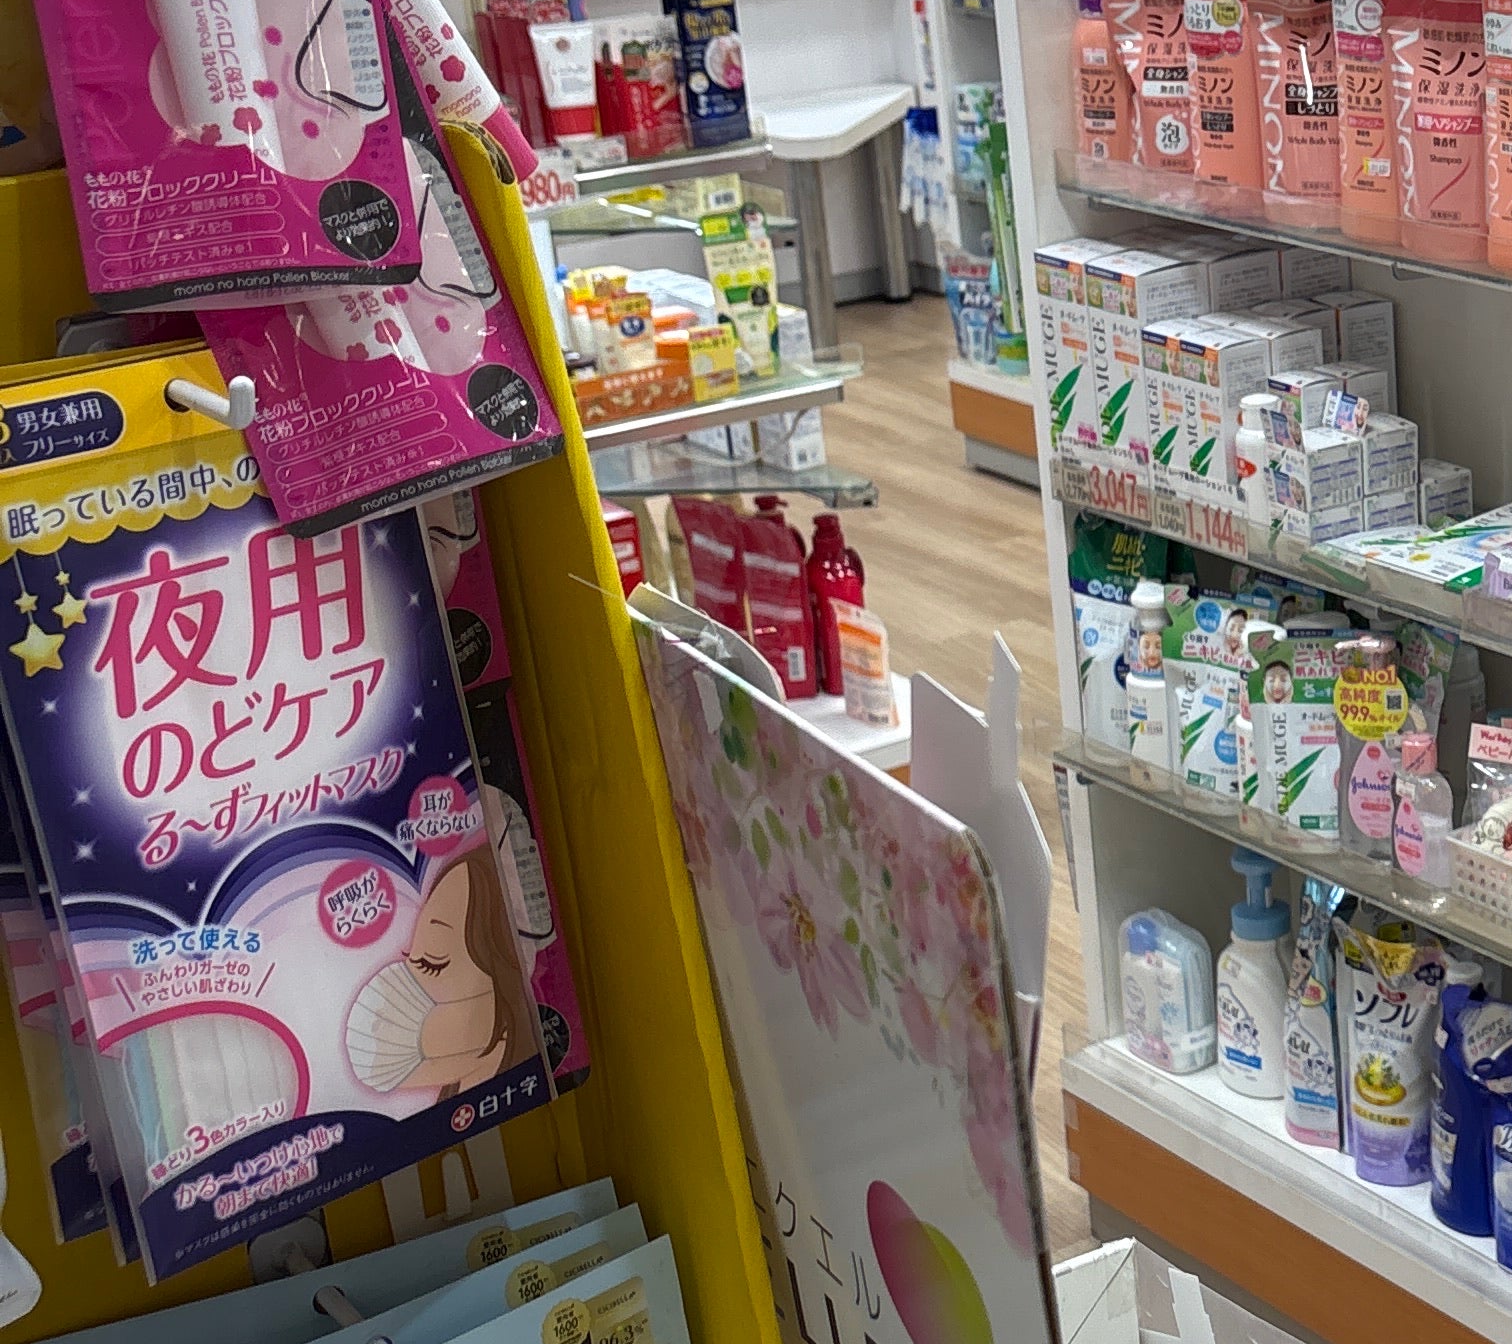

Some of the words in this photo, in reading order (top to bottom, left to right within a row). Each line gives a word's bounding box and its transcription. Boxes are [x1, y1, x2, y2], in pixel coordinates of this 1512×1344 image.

[17, 399, 103, 435] 男女兼用
[91, 525, 367, 717] 夜用
[124, 661, 384, 798] のどケア
[132, 930, 262, 964] 洗って使える
[478, 1076, 538, 1118] 白十字
